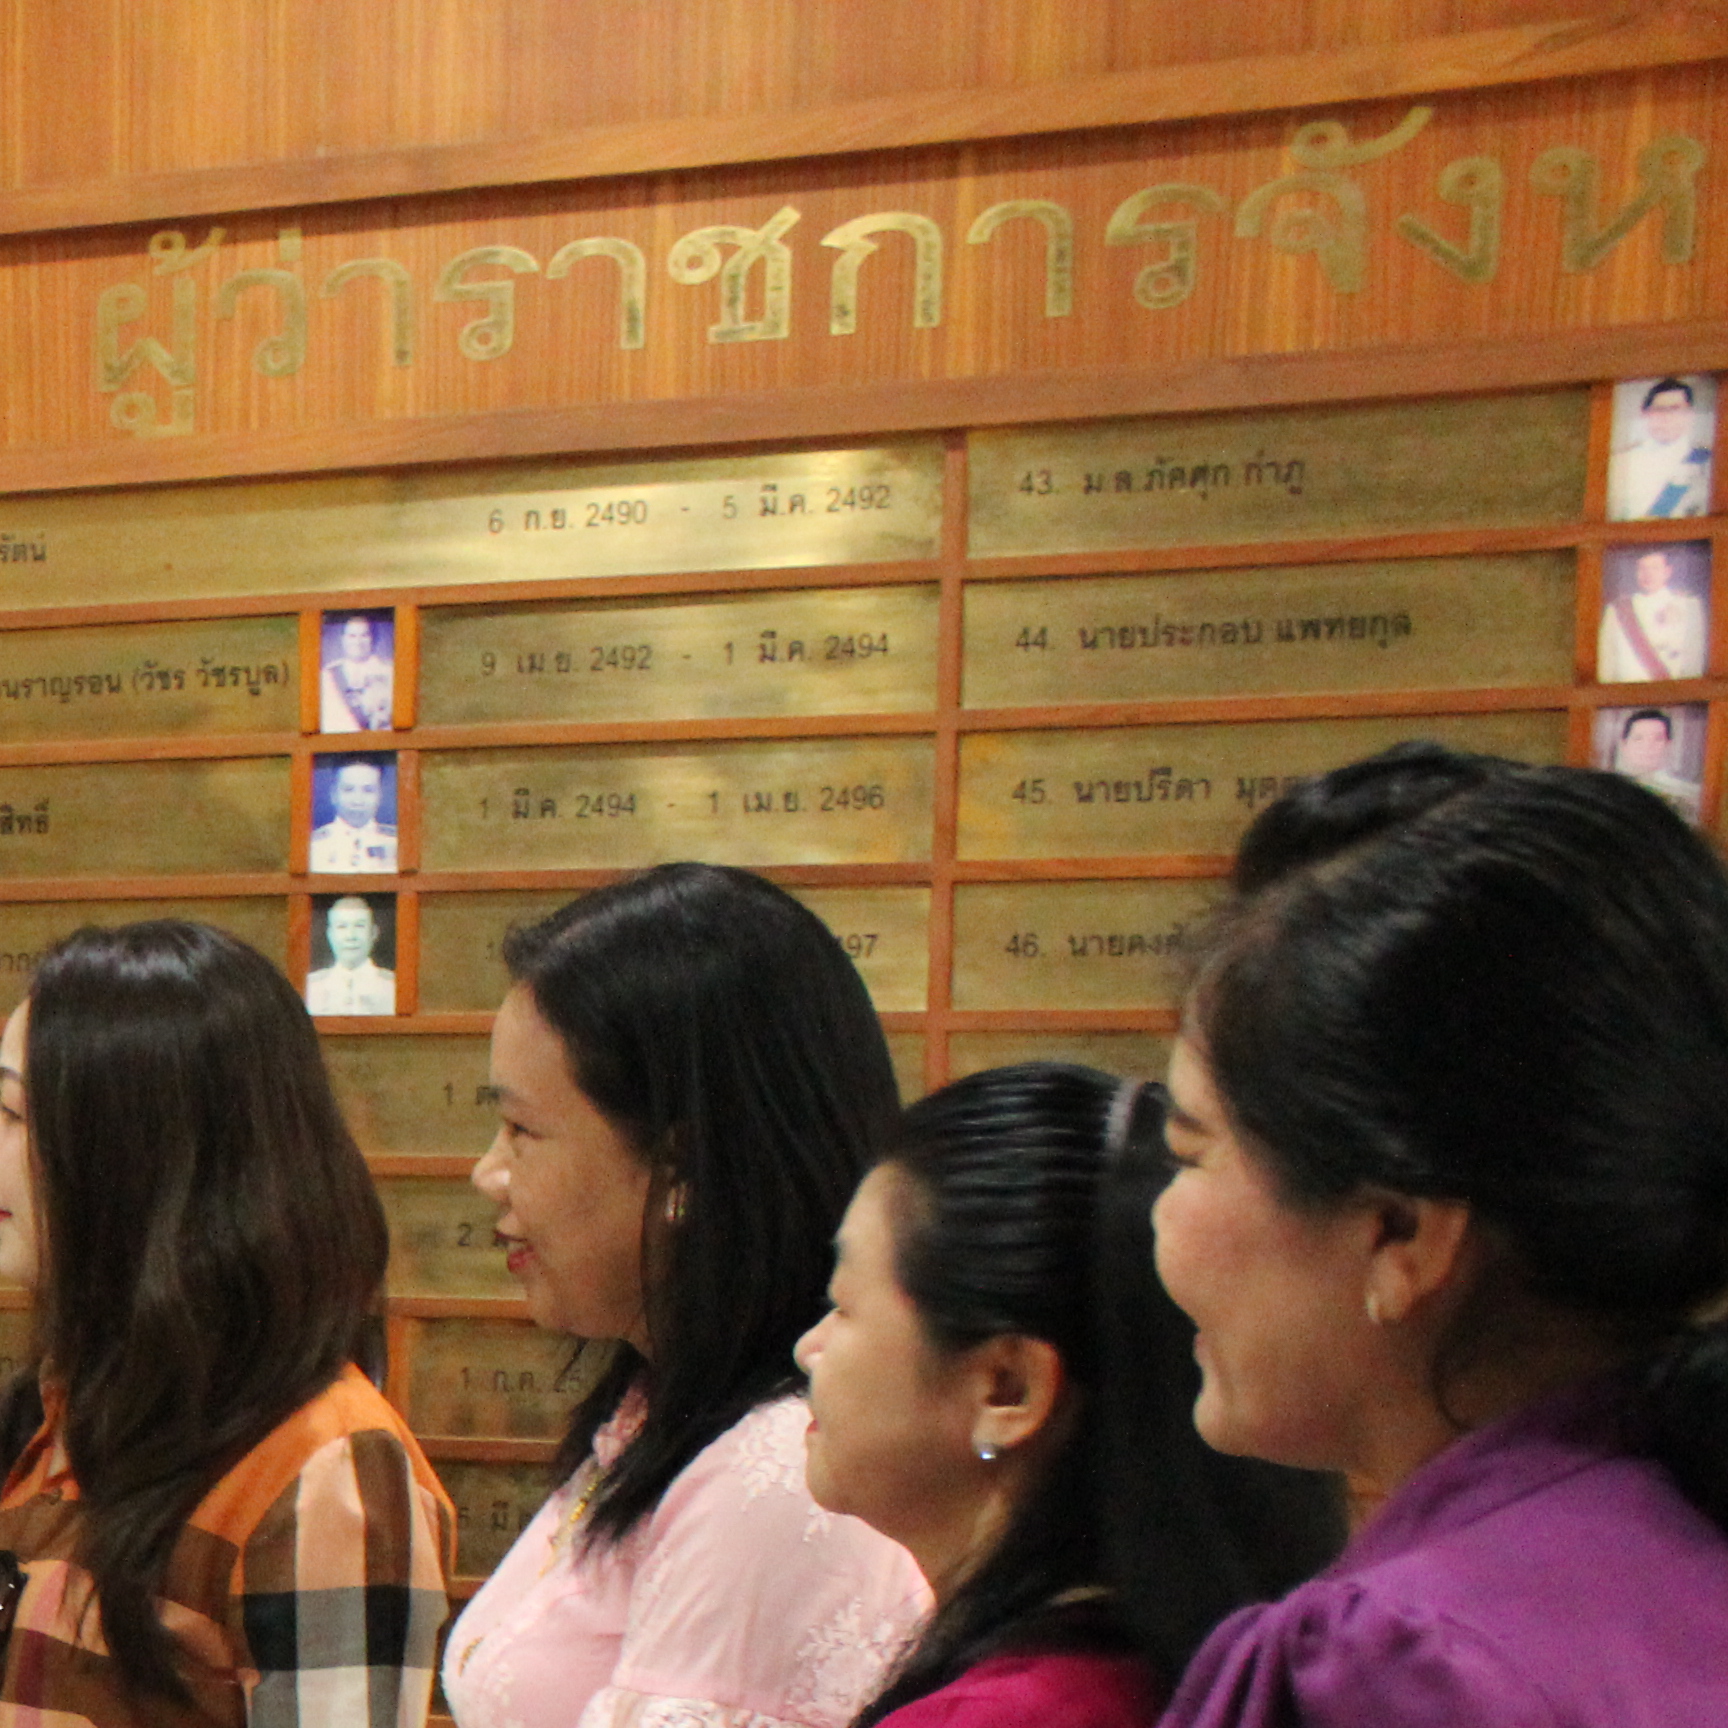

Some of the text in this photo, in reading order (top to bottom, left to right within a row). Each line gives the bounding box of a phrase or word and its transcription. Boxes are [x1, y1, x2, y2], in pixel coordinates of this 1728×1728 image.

[487, 508, 505, 535] 6
[585, 499, 648, 528] 2490
[721, 494, 738, 520] 5
[824, 484, 892, 514] 2492
[480, 651, 497, 677] 9
[589, 644, 653, 672] 2492
[723, 640, 735, 666] 1
[823, 632, 890, 662] 2494
[478, 796, 490, 820] 1
[575, 793, 637, 819] 2494
[708, 790, 720, 814] 1
[819, 785, 885, 813] 2496
